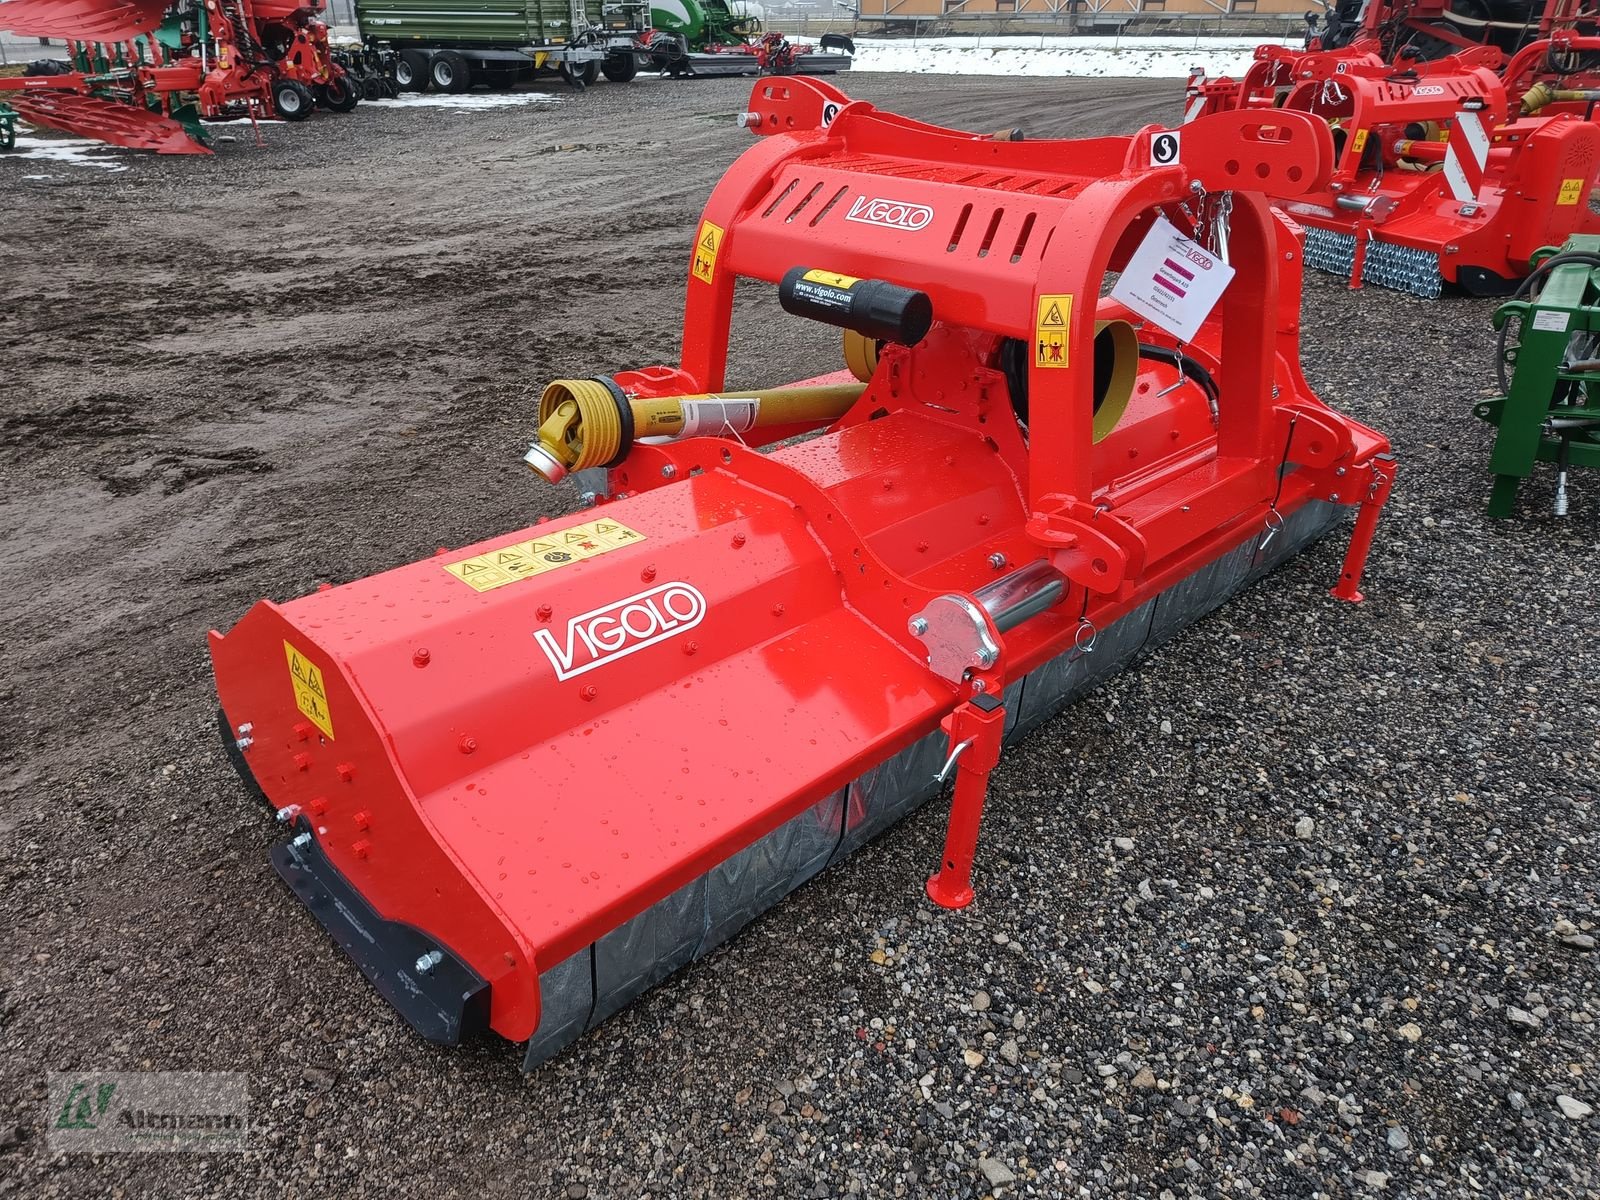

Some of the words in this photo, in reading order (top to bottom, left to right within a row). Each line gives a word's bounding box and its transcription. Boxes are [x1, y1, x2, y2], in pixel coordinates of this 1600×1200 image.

[845, 195, 935, 231] VIGOLO
[1186, 248, 1213, 270] VIGOLO
[796, 283, 851, 302] www.vigolo.com
[533, 581, 707, 682] VIGOLO
